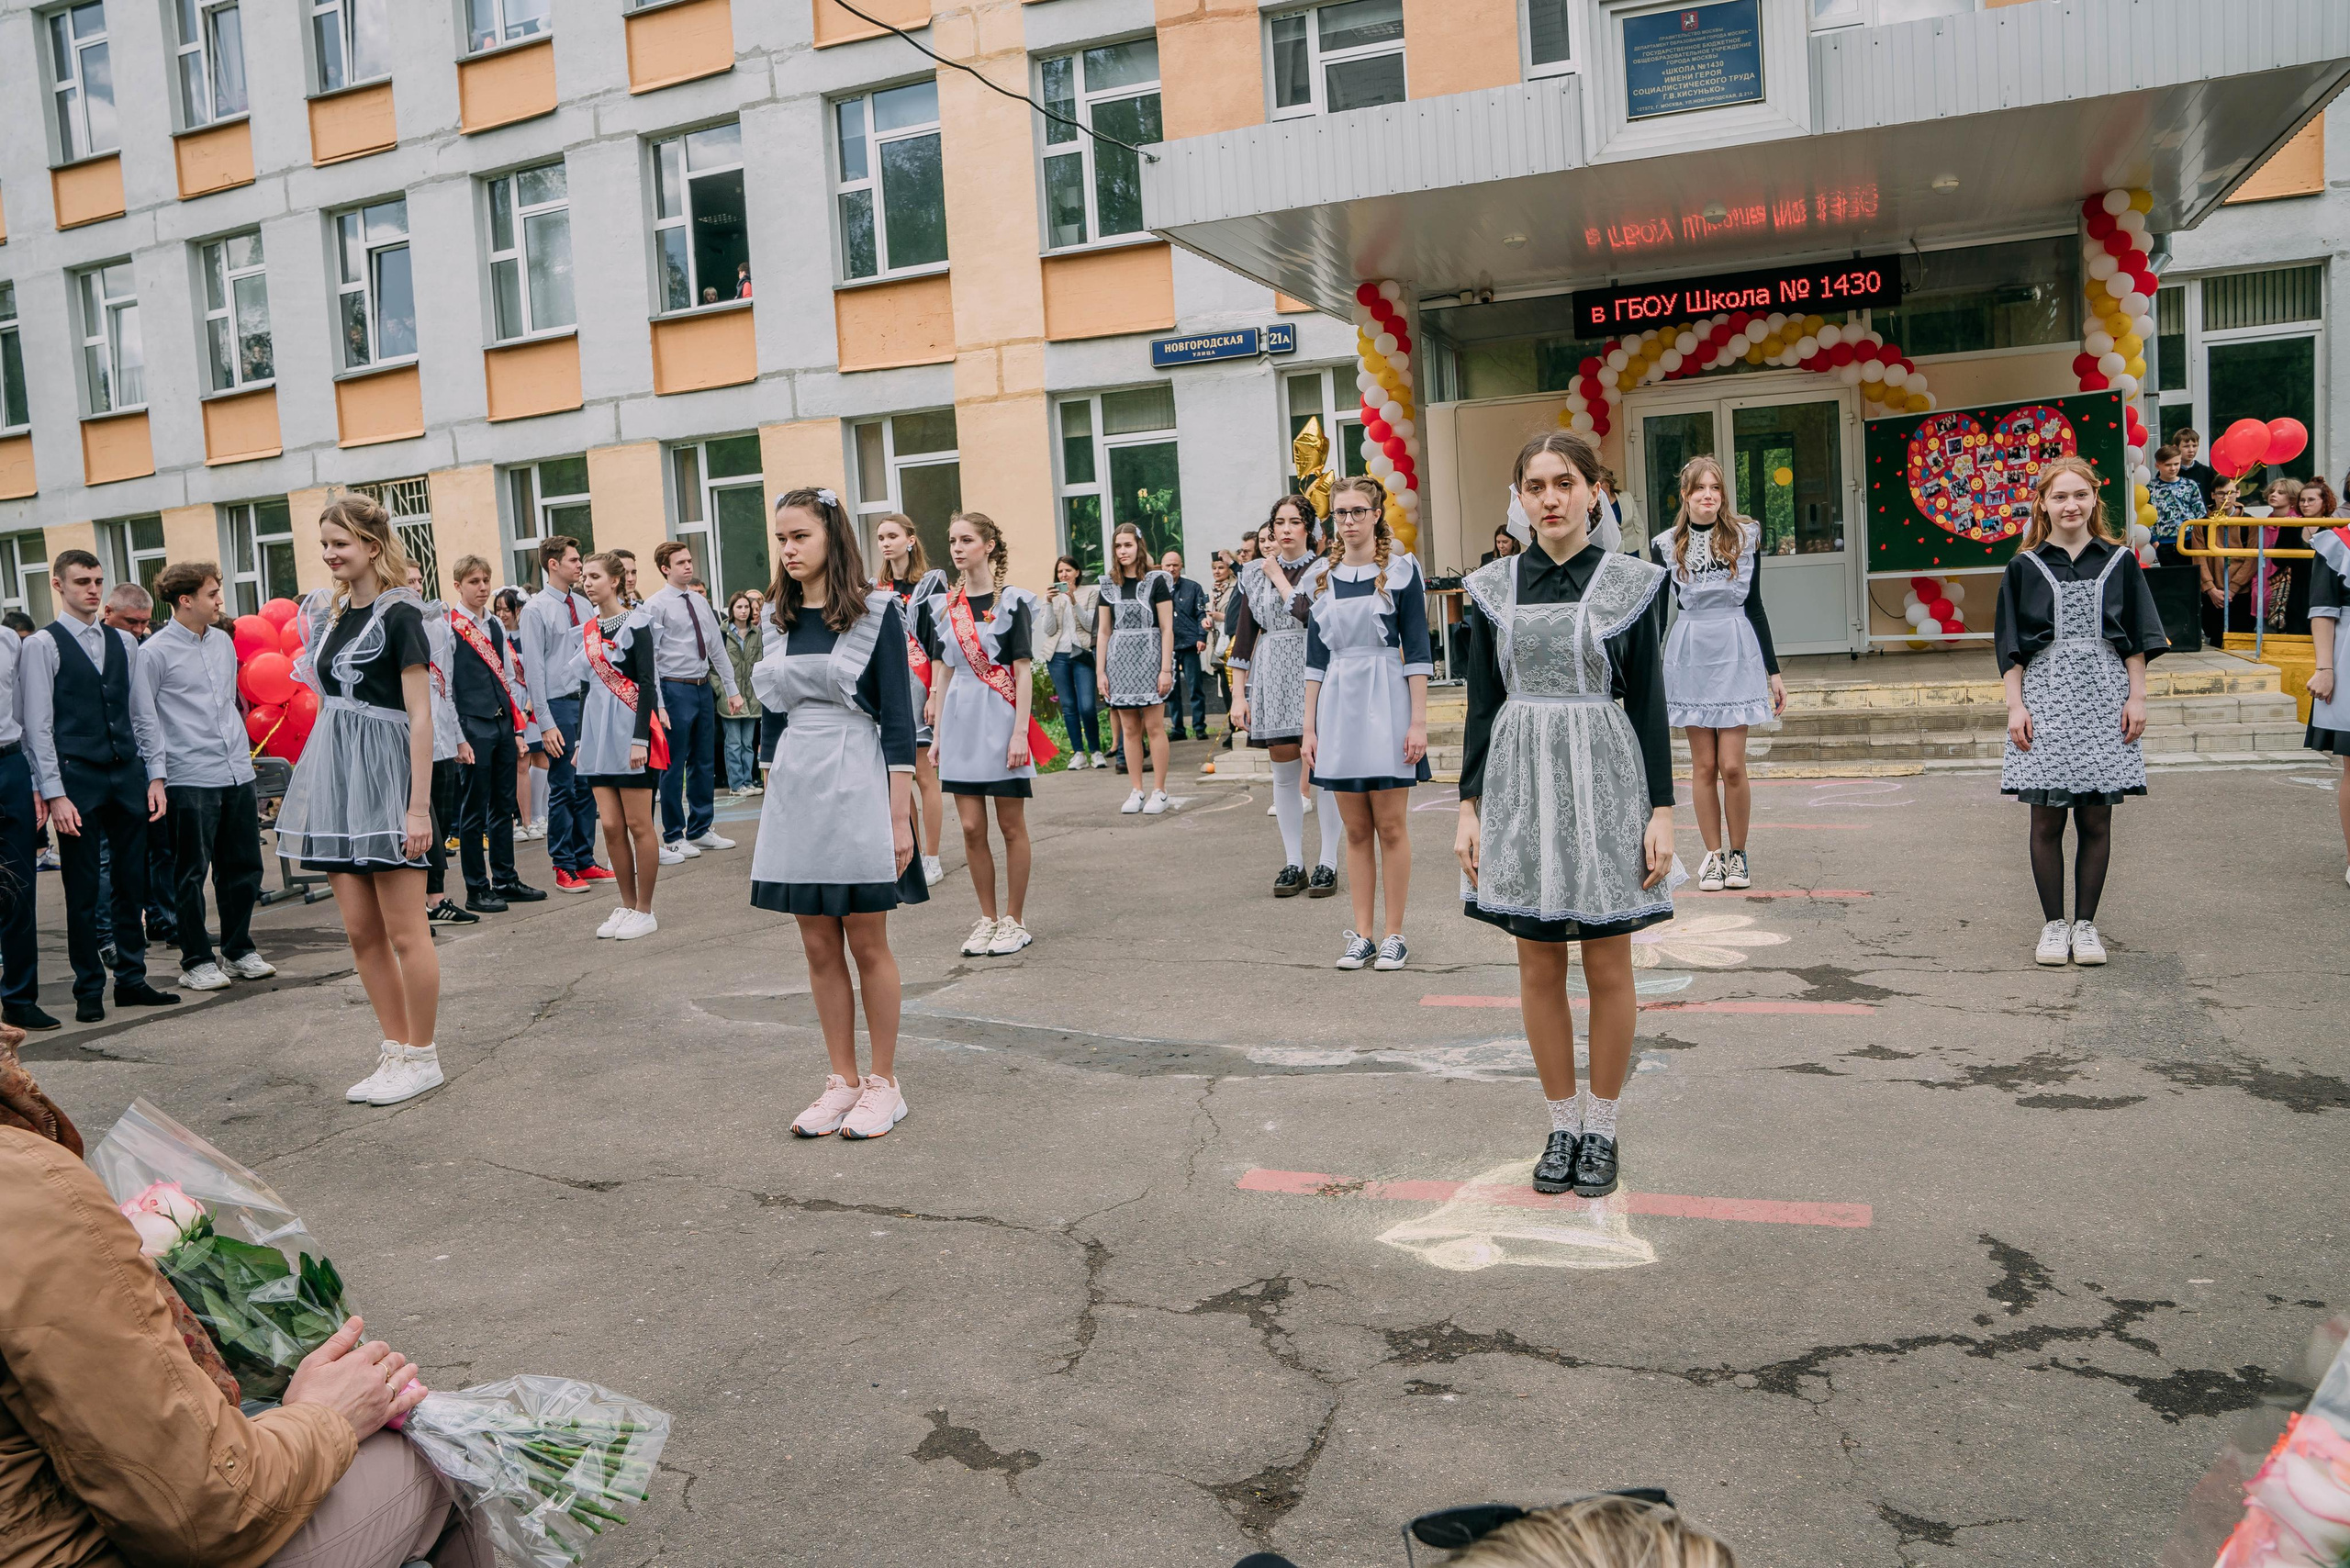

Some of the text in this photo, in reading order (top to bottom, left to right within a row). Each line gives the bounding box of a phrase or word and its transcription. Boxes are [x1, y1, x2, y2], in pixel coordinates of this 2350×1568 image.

[1659, 27, 1724, 41] ПРАВИТЕЛЬСТВО МОСКВЫ
[1634, 41, 1669, 51] ДЕПАРТАМЕНТ
[1670, 36, 1706, 46] ОБРАЗОВАНИЯ
[1642, 37, 1741, 57] ГОСУДАРСТВЕННОЕ БЮДЖЕТНОЕ
[1632, 40, 1752, 64] ОБЩЕОБРАЗОВАТЕЛЬНОЕ УЧРЕЖДЕНИЕ
[1666, 52, 1718, 65] ГОРОДА МОСКВЫ
[1662, 60, 1724, 75] «ШКОЛА №1430
[1632, 72, 1755, 96] СОЦИАЛИСТИЧЕСКОГО ТРУДА
[1664, 69, 1722, 84] ИМЕНИ ГЕРОЯ
[1591, 270, 1881, 324] в ГБОУ Школа № 1430
[1164, 334, 1244, 353] НОВГОРОДСКАЯ
[1269, 332, 1291, 345] 21А
